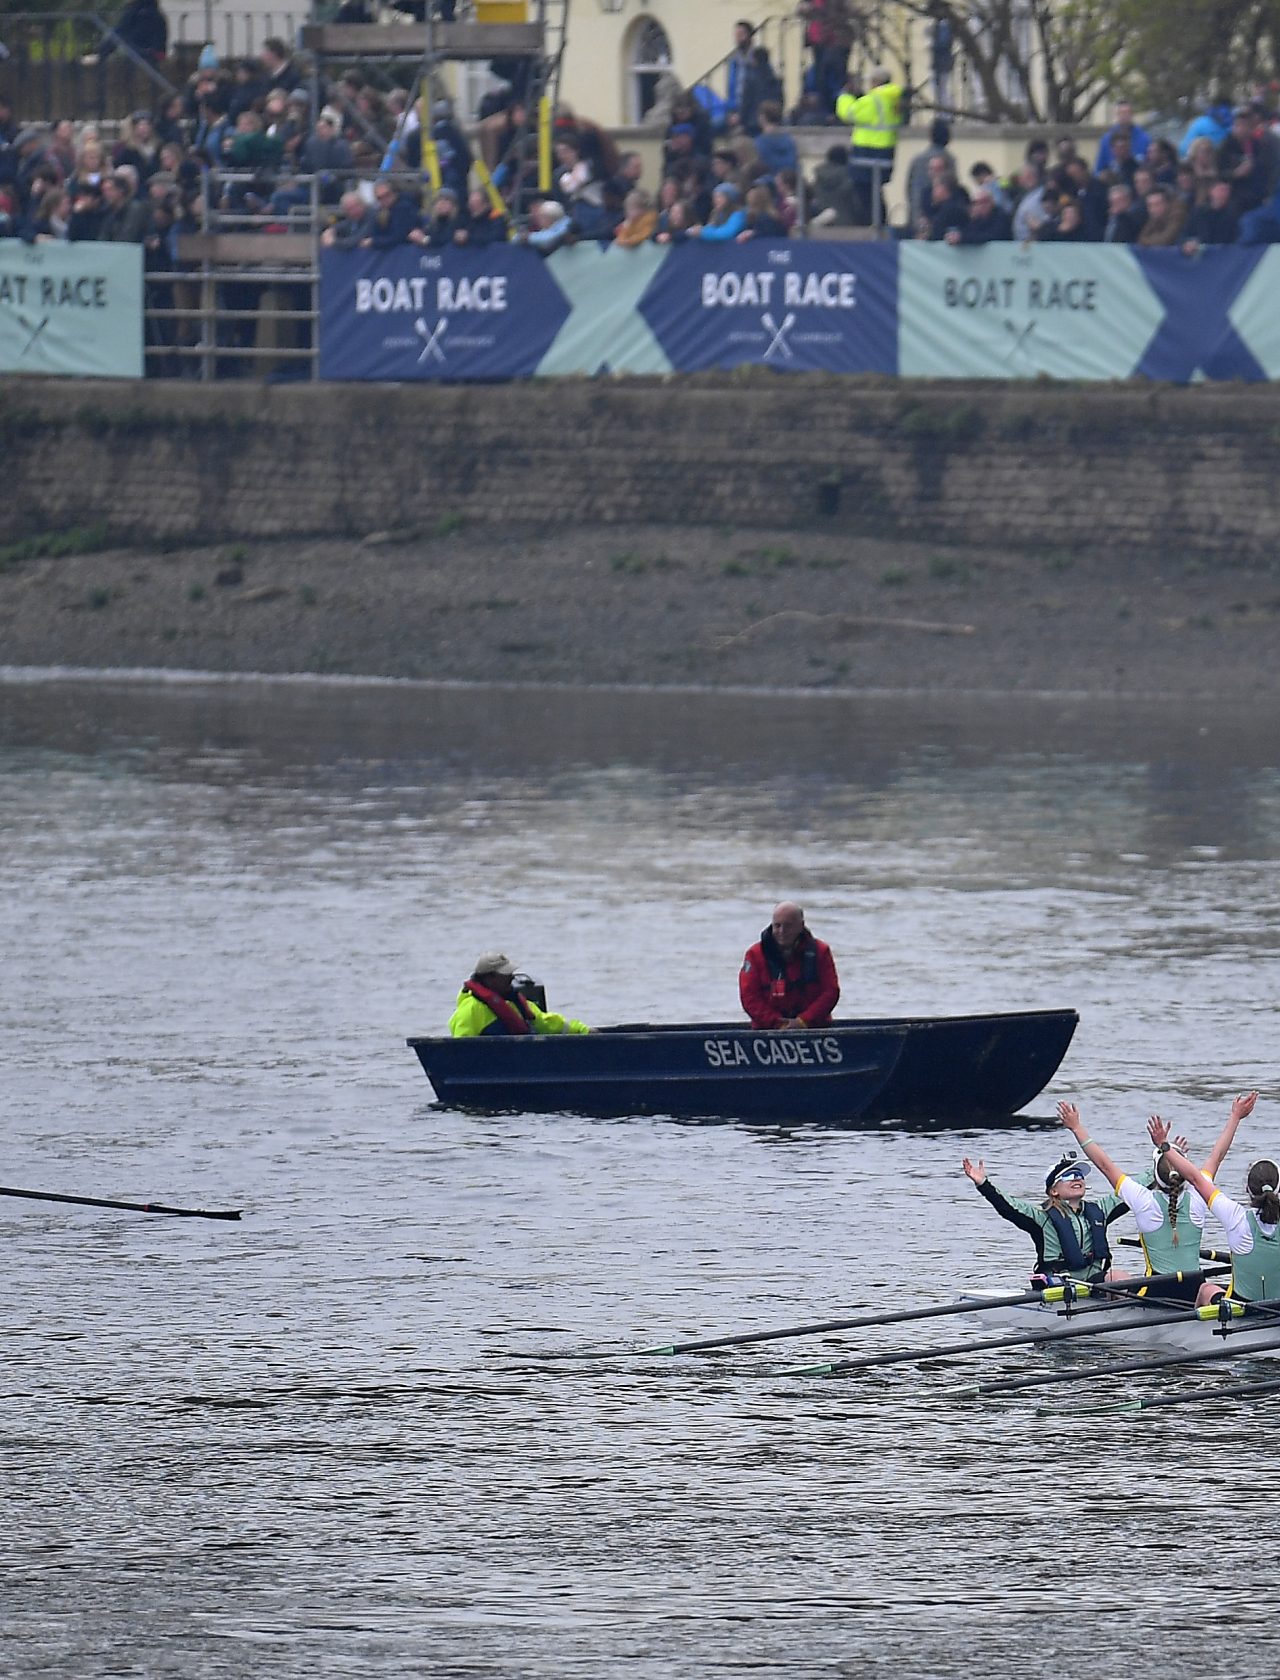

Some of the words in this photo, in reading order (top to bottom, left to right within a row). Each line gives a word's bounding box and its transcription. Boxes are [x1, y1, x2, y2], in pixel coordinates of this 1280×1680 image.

[41, 276, 107, 309] RACE
[356, 277, 427, 312] BOAT
[437, 276, 507, 311] RACE
[702, 272, 775, 308] BOAT
[784, 272, 856, 308] RACE
[944, 277, 1015, 309] BOAT
[1028, 279, 1097, 311] RACE
[704, 1039, 750, 1066] SEA
[753, 1037, 843, 1065] CADETS
